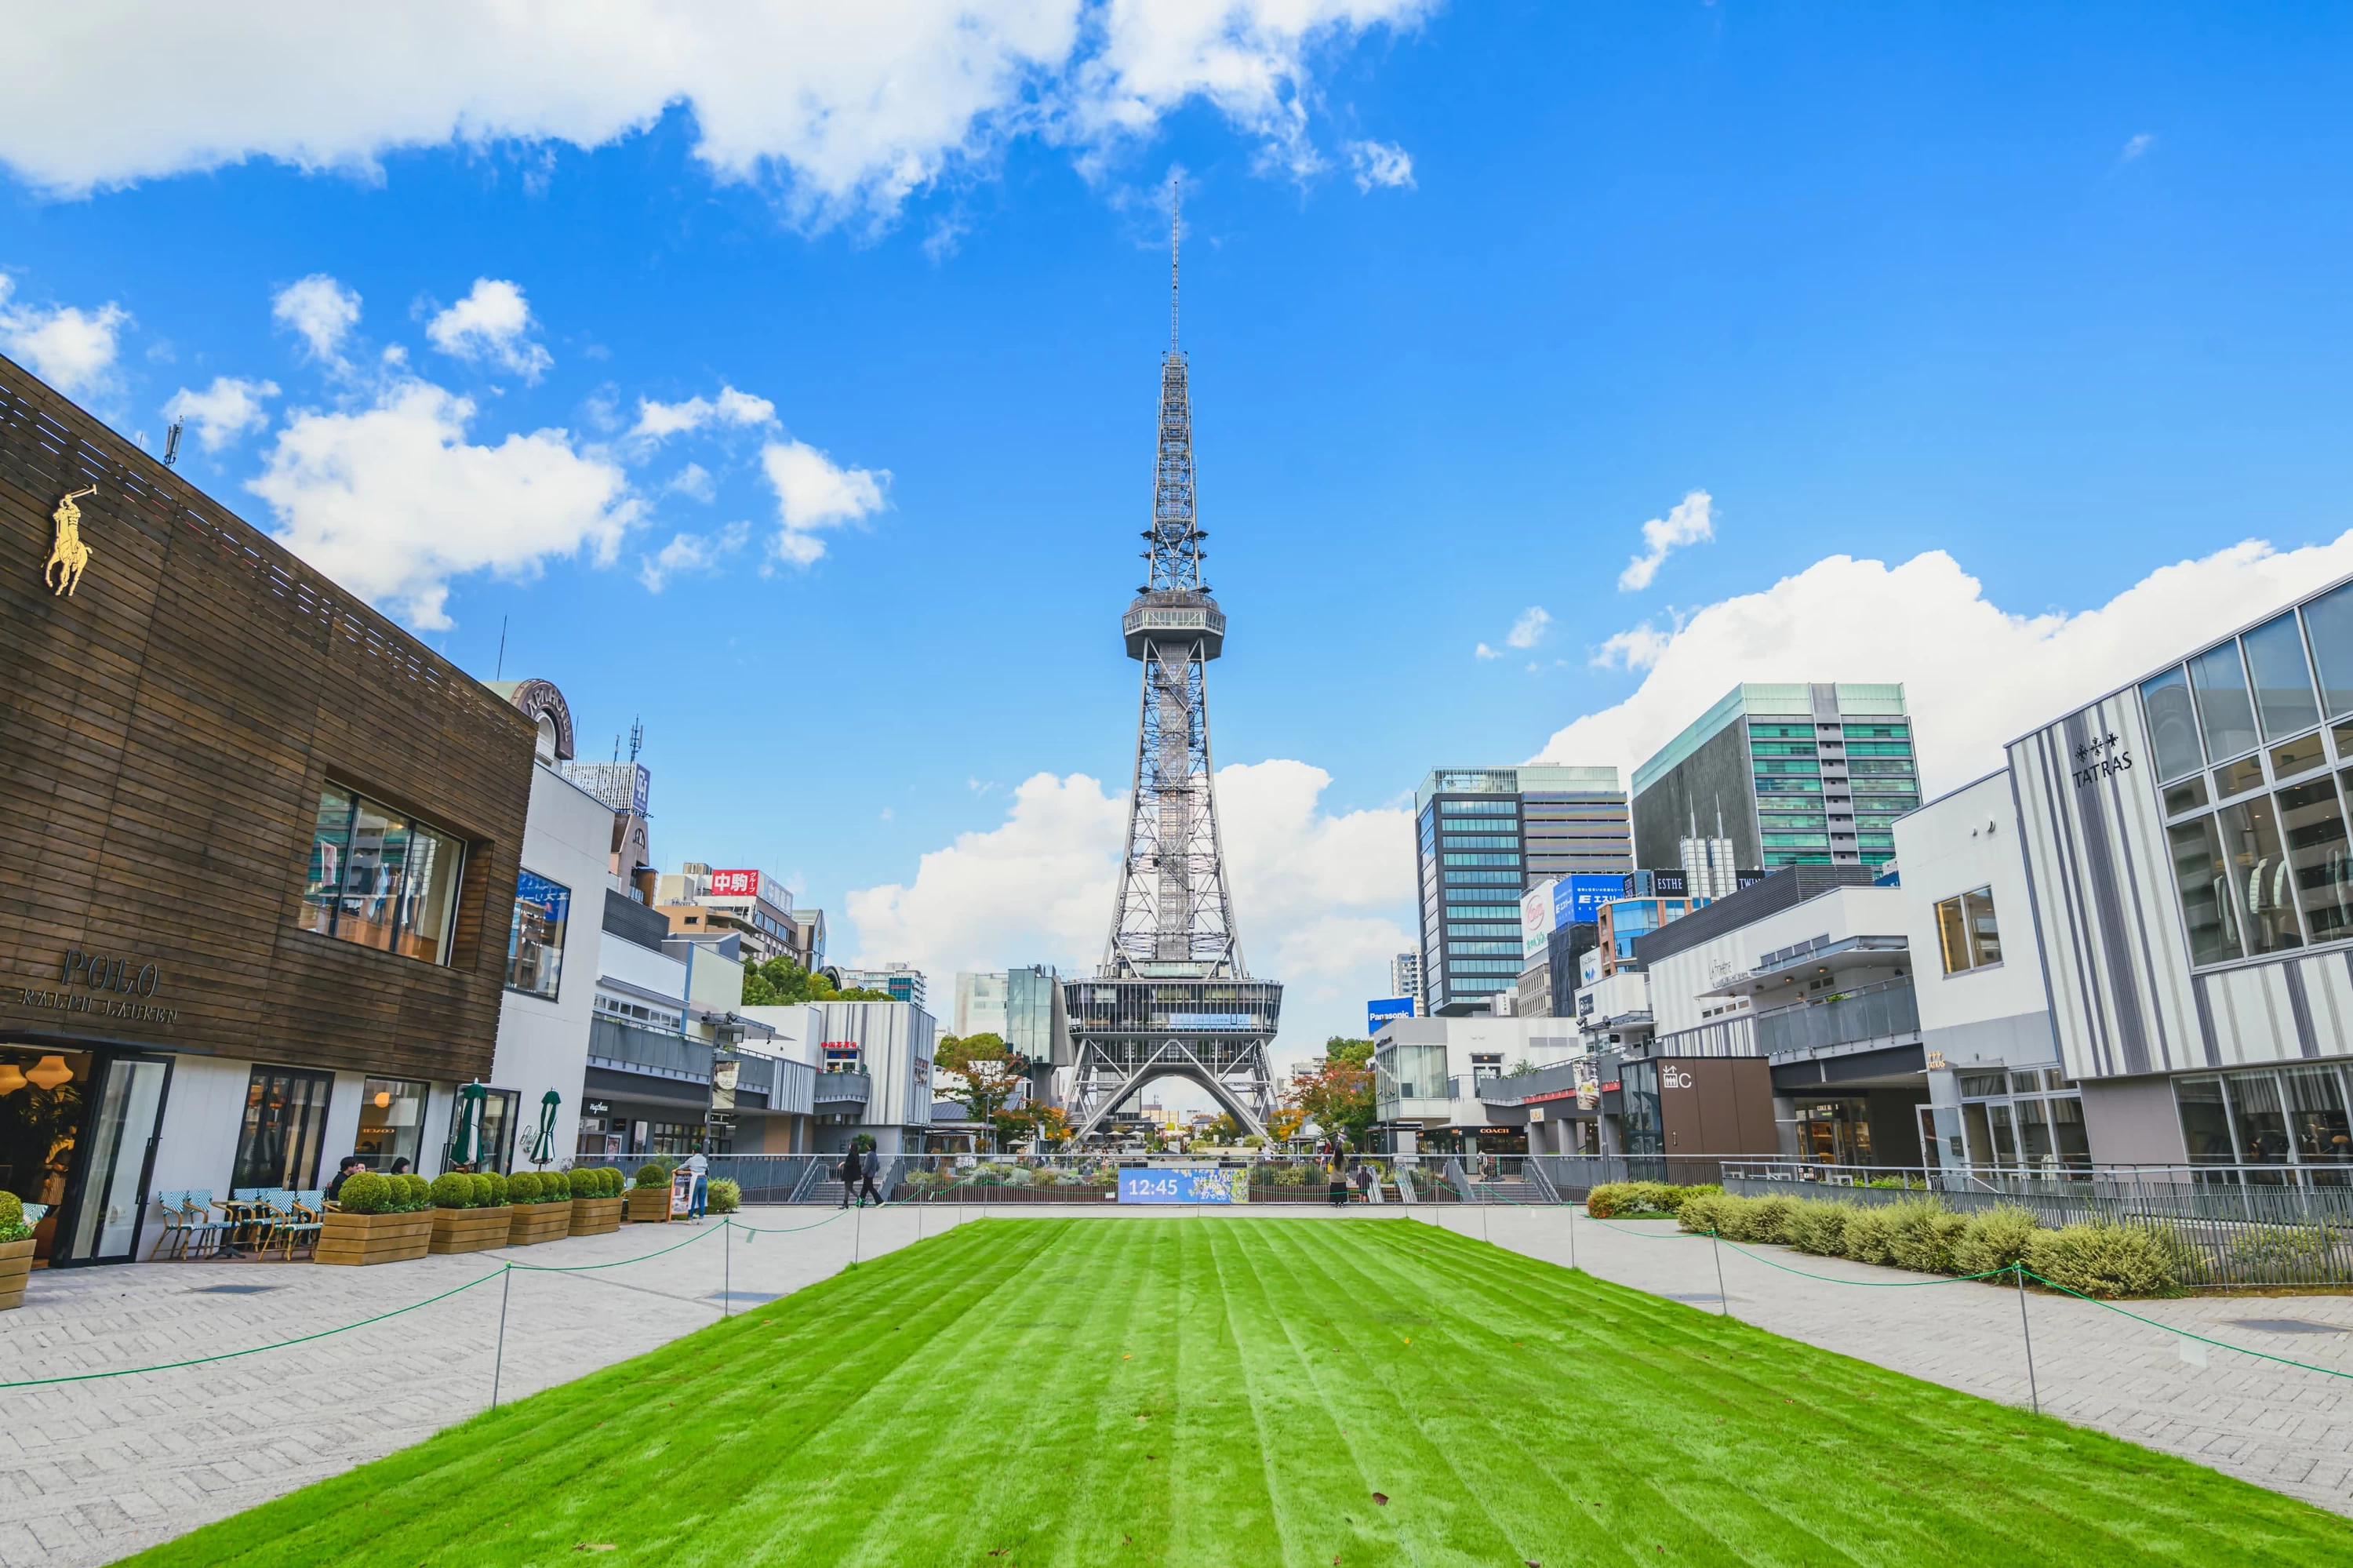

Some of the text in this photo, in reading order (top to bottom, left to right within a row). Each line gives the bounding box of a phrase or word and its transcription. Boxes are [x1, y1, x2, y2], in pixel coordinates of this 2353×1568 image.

[548, 689, 571, 743] HOTEL
[2072, 751, 2133, 788] TATRAS
[714, 872, 748, 892] 中駒
[1657, 878, 1682, 890] ESTHE
[61, 949, 159, 999] POLO
[22, 988, 178, 1024] RALPH LAUREN
[1678, 1073, 1692, 1088] C
[1129, 1179, 1178, 1195] 12:45
